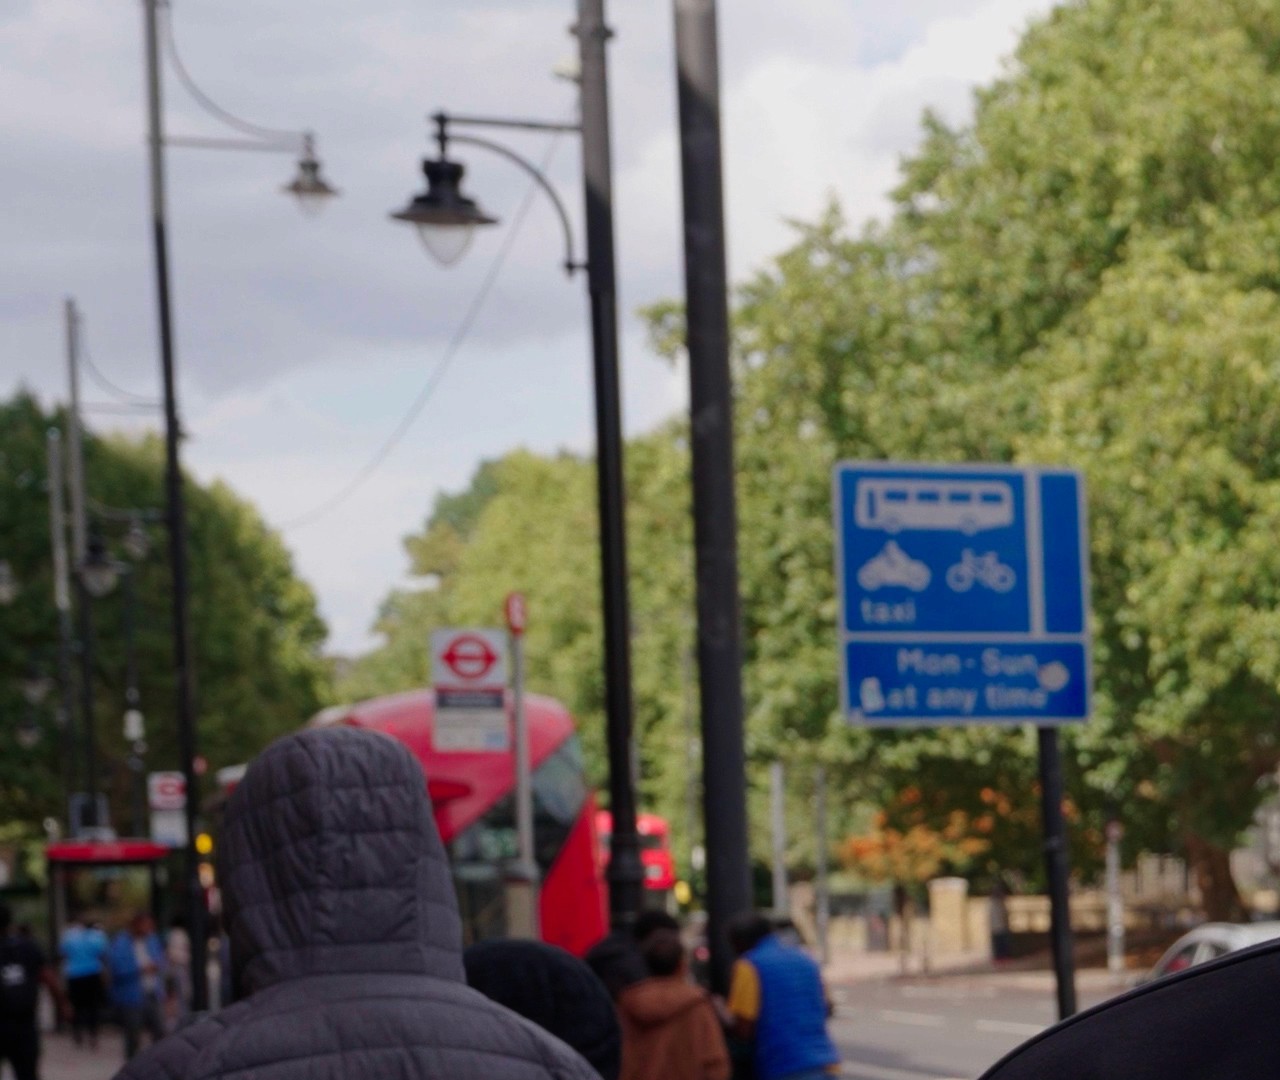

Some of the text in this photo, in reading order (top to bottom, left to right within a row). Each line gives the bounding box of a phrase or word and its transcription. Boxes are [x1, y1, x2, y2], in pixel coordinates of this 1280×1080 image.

[861, 597, 917, 625] taxi
[897, 648, 962, 677] Mon
[981, 648, 1039, 677] Sun
[925, 688, 979, 716] any
[984, 683, 1049, 711] time
